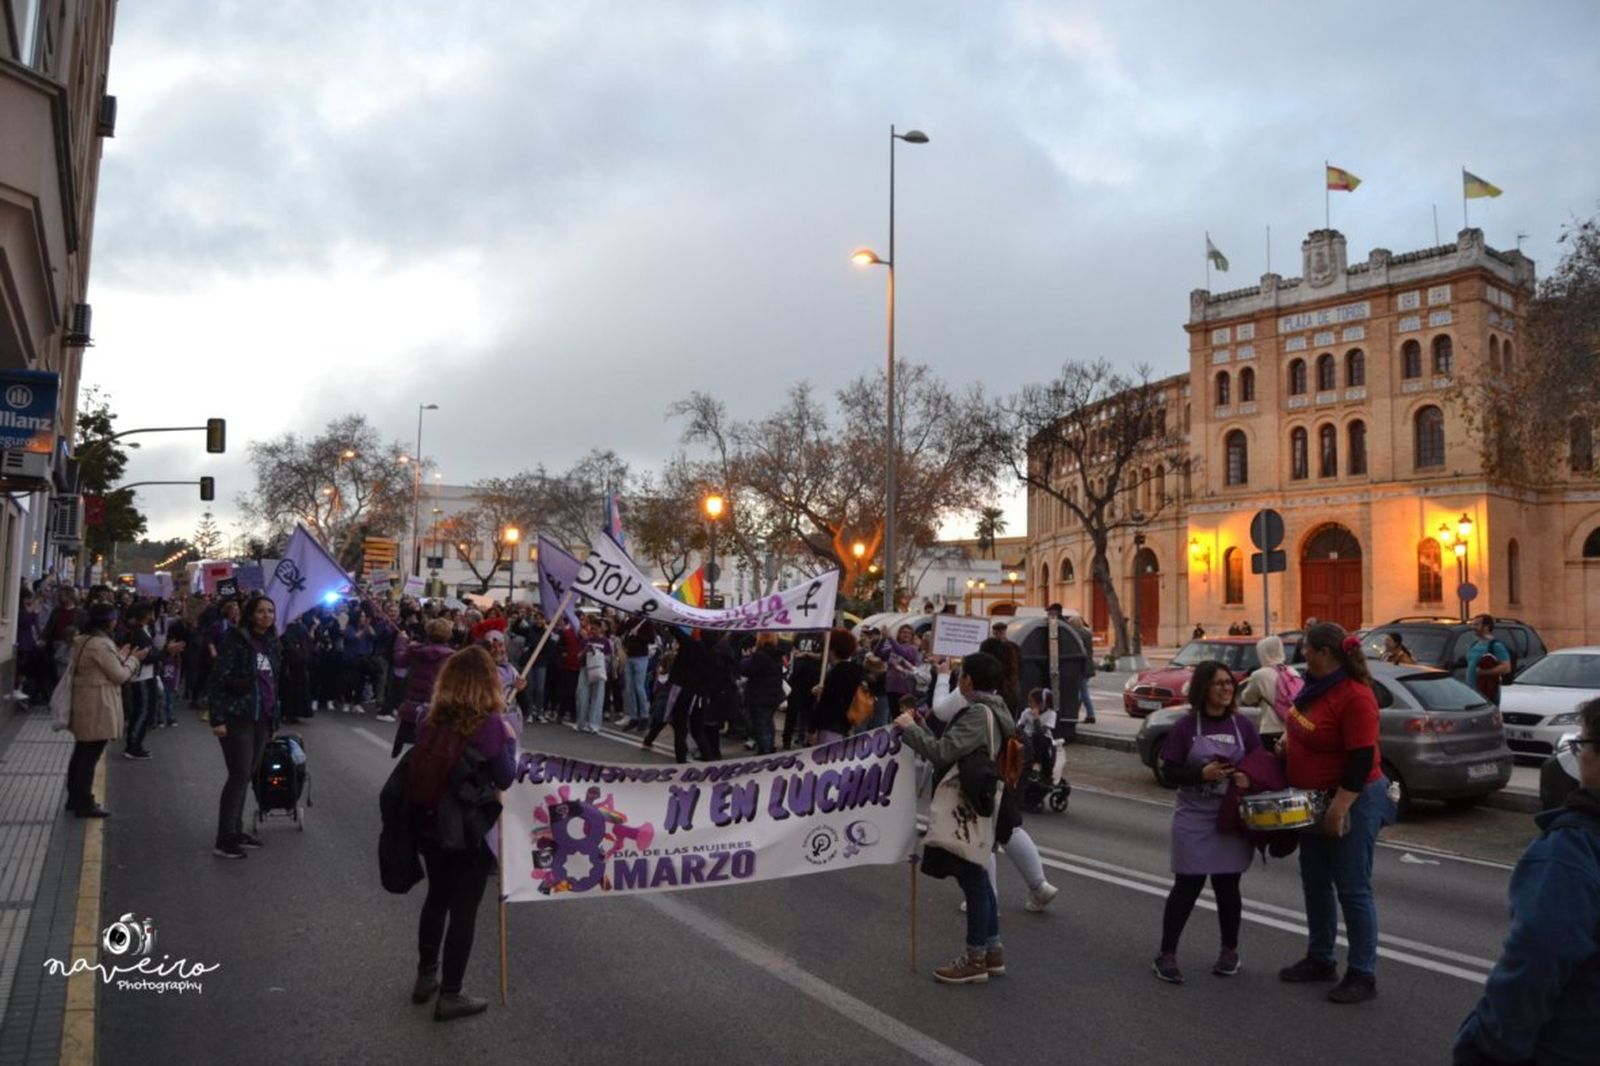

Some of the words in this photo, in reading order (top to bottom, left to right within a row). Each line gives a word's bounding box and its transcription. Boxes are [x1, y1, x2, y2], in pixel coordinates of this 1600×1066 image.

[1283, 314, 1313, 331] PLAZA
[1317, 311, 1330, 325] DE
[1336, 304, 1367, 321] TOROS
[0, 411, 52, 431] llianz
[0, 435, 39, 449] eguros
[575, 551, 642, 601] STOP
[515, 752, 679, 785] FEMINISMOS
[812, 726, 902, 765] UNIDOS
[710, 779, 760, 827] EN
[767, 759, 899, 820] LUCHA!
[549, 800, 607, 893] 8
[614, 848, 639, 858] DÍA
[642, 848, 661, 857] DE
[664, 845, 690, 856] LAS
[692, 840, 753, 853] MUJERES
[613, 848, 756, 891] MARZO
